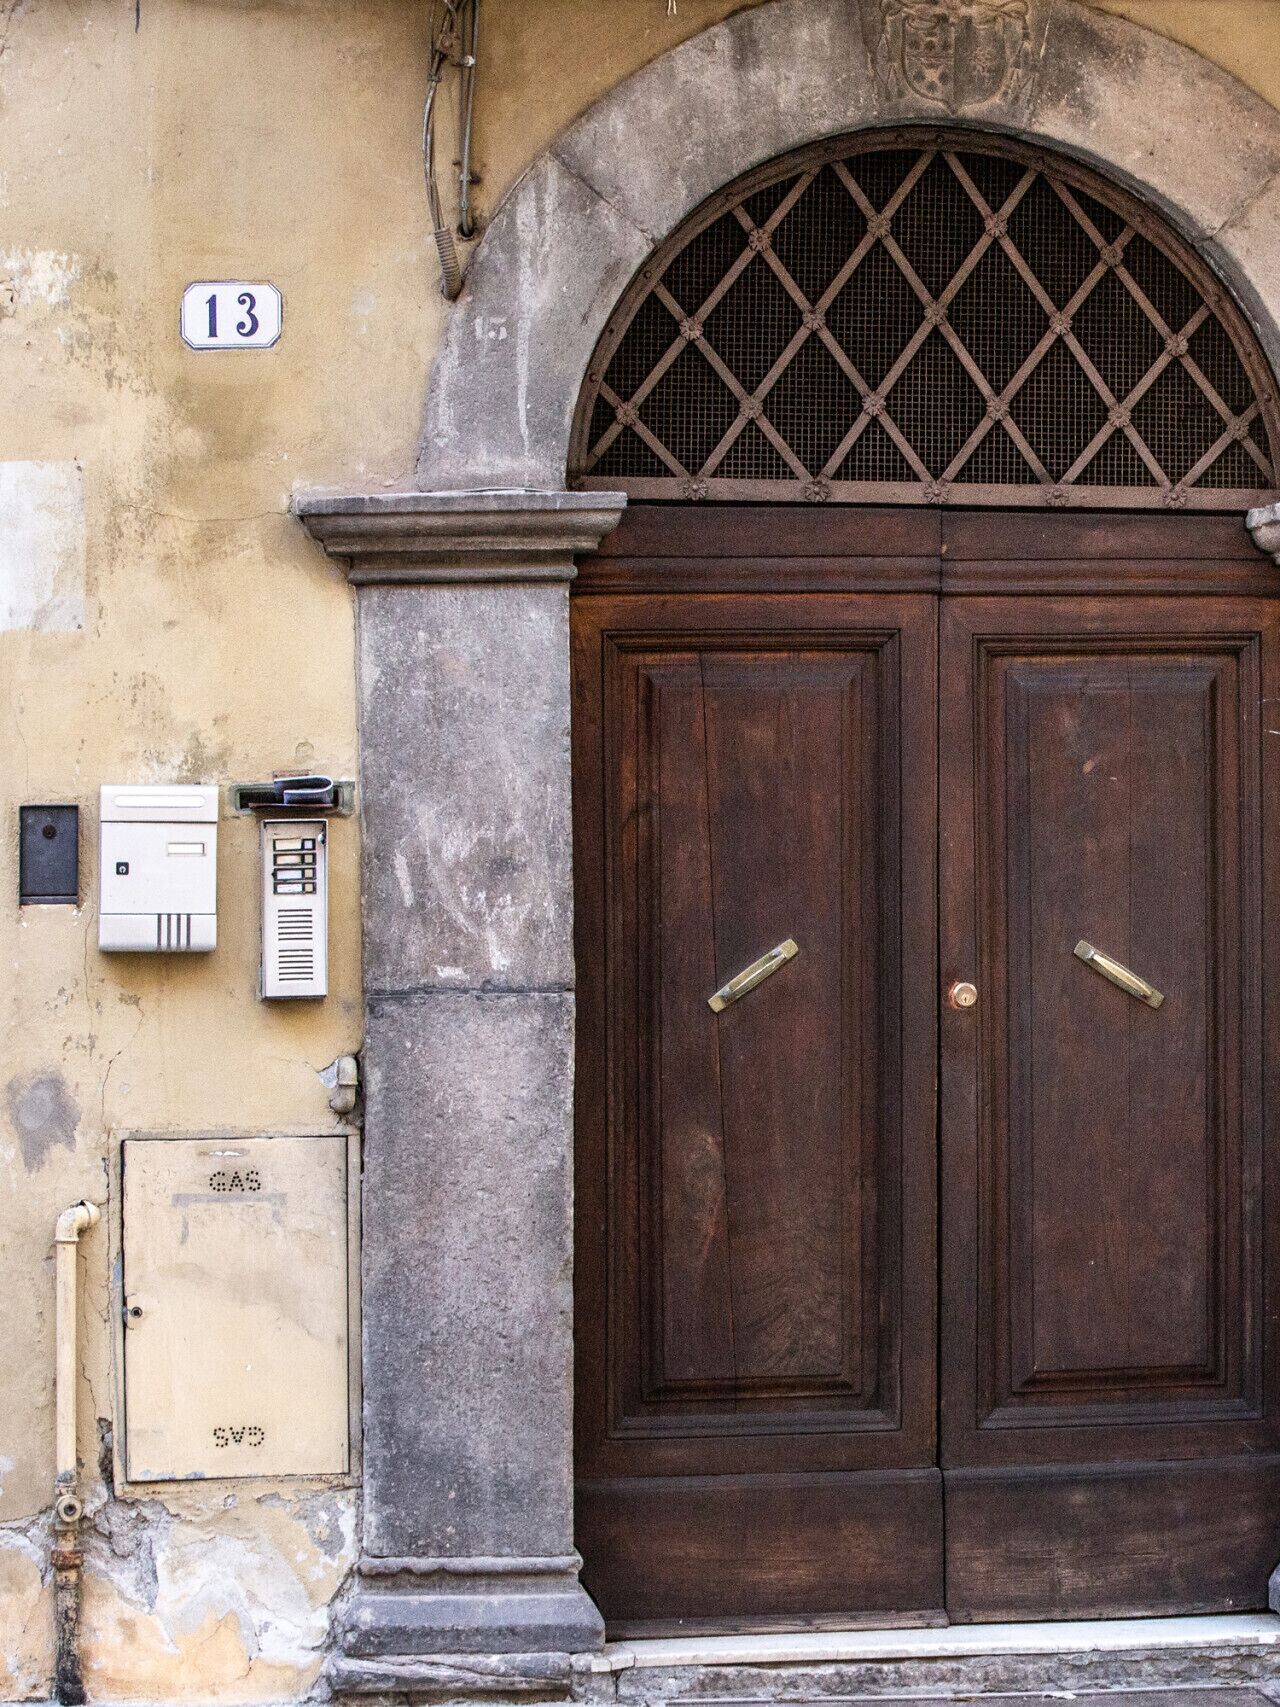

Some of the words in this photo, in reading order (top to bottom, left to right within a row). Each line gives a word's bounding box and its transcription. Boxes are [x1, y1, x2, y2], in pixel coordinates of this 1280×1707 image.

[205, 292, 259, 338] 13
[209, 1170, 261, 1192] GAS
[213, 1426, 265, 1447] GAS
